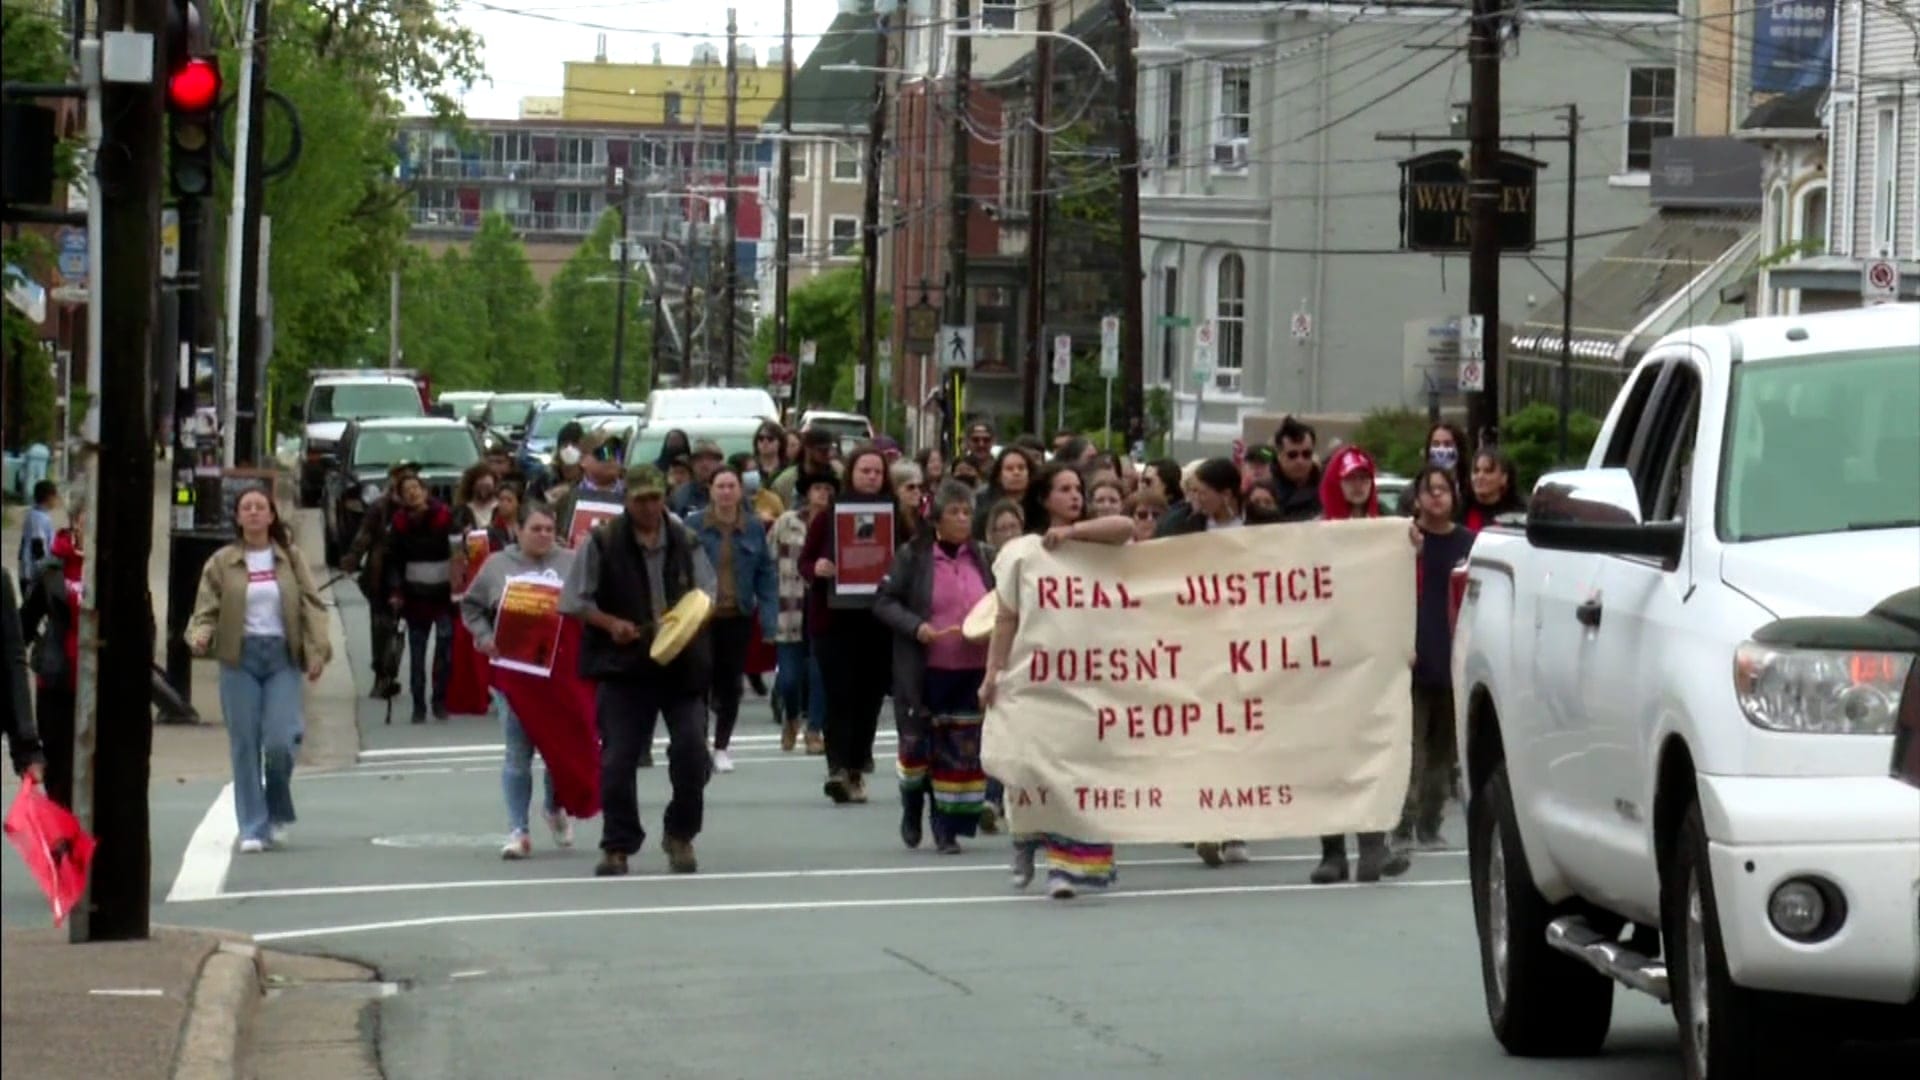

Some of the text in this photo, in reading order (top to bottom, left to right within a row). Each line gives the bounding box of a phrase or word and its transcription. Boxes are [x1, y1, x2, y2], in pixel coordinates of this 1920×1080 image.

[1771, 3, 1826, 20] Lease
[1416, 185, 1530, 212] WAVEEY
[1037, 565, 1334, 610] REAL JUSTICE
[1030, 635, 1333, 683] DOESN'T KILL
[1097, 697, 1265, 741] PEOPLE
[1010, 784, 1295, 811] AY THEIR NAMES
